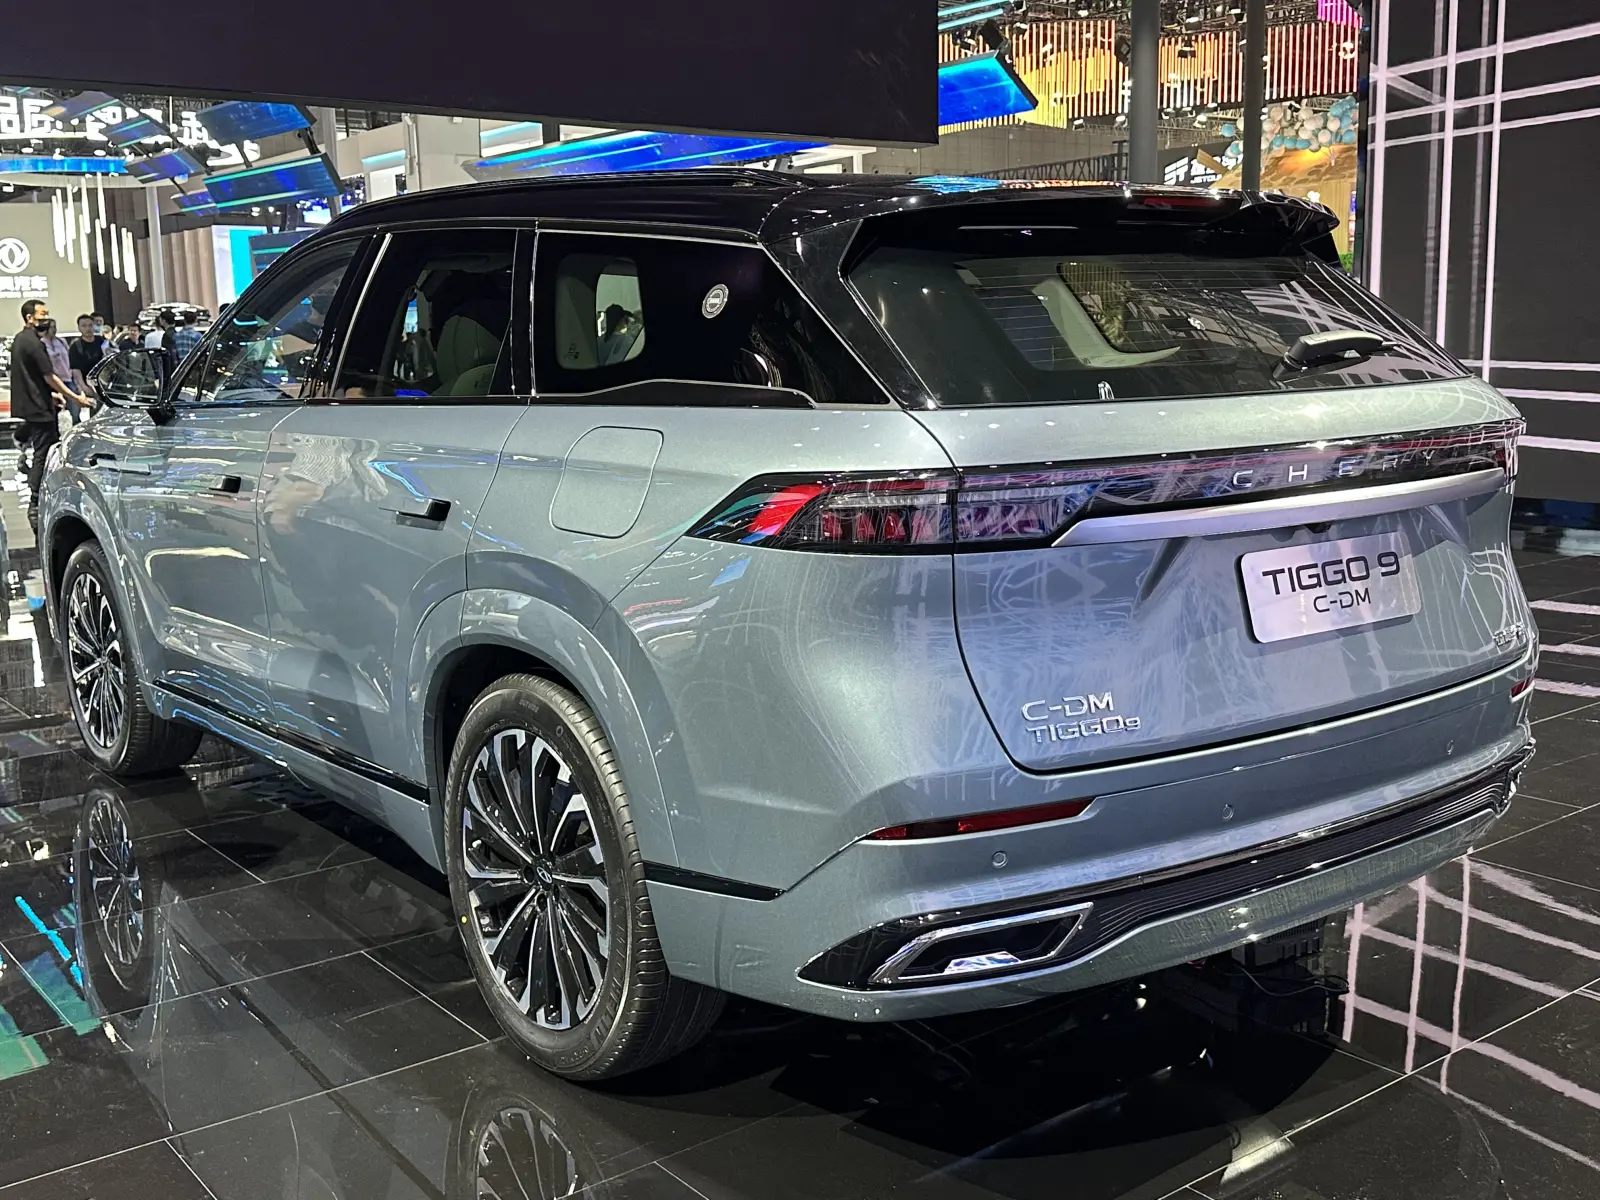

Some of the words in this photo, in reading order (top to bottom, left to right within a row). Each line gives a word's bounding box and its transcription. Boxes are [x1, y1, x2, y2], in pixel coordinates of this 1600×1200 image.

[1233, 451, 1436, 488] CHERY
[1262, 556, 1370, 595] TIGGO
[1378, 551, 1400, 577] 9
[1313, 588, 1371, 613] C-DM
[1021, 691, 1114, 721] C-DM
